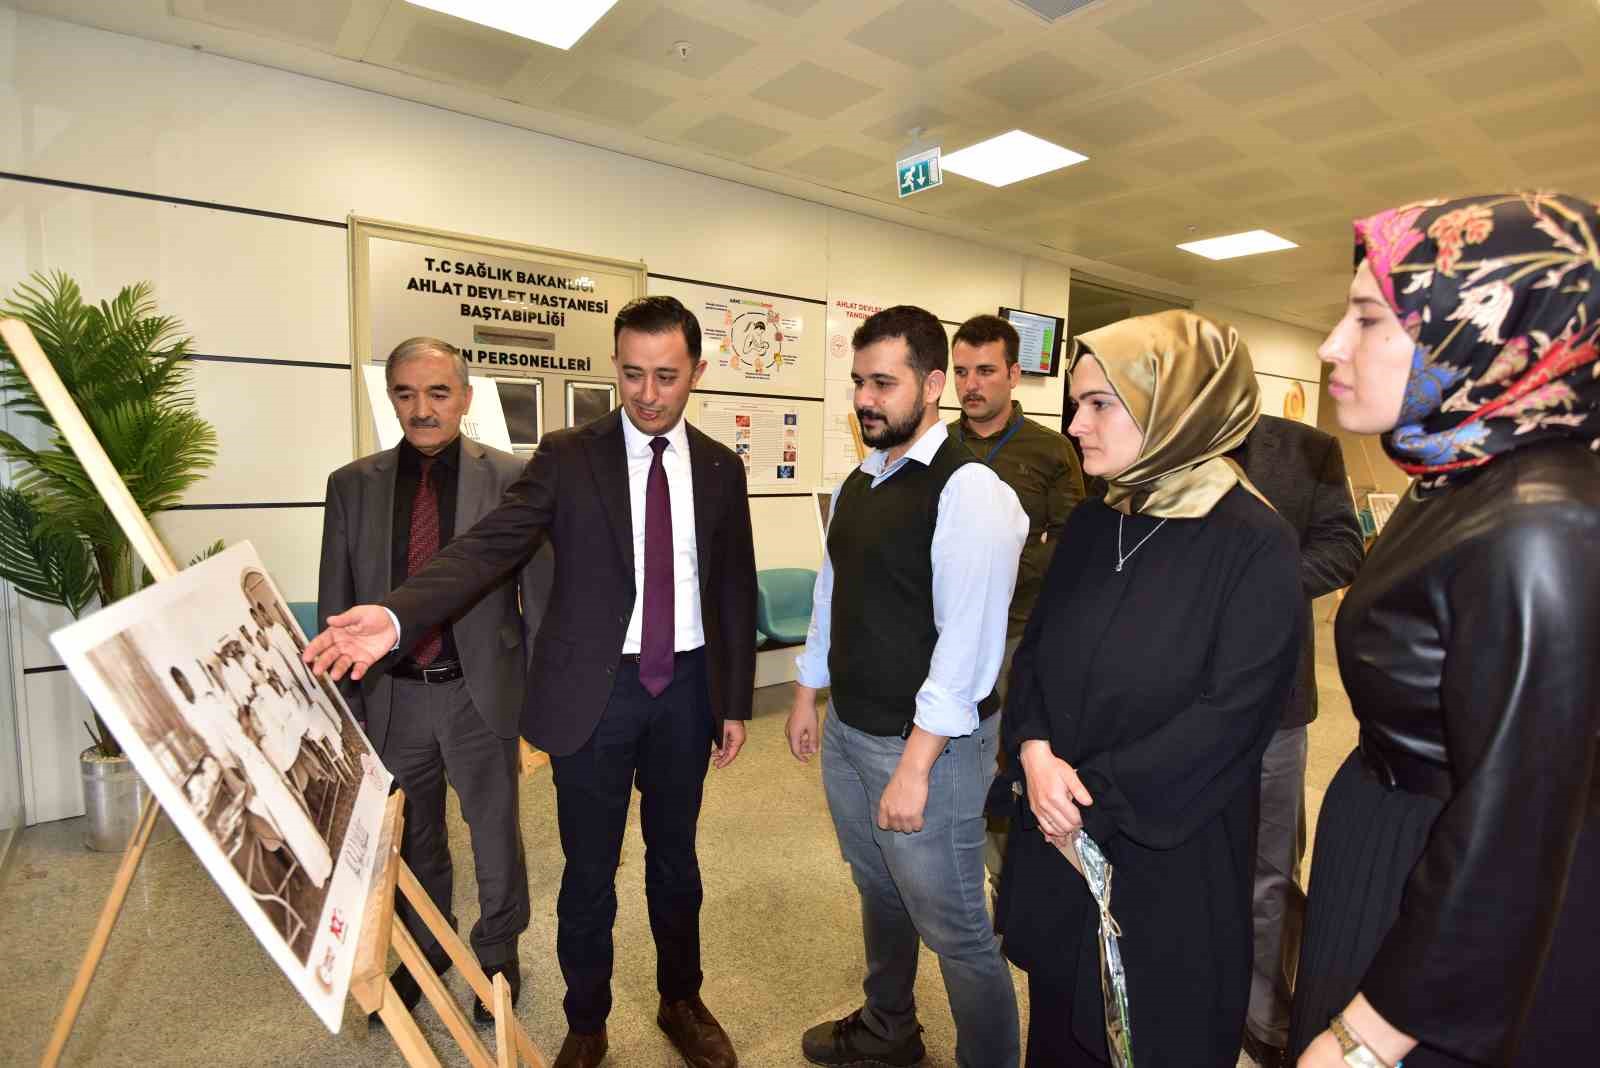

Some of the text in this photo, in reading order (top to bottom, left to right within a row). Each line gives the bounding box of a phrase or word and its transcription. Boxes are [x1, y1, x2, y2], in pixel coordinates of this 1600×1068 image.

[425, 257, 451, 273] T.C
[455, 261, 512, 282] SAĞLIK
[406, 277, 608, 314] AHLAT DEVLET HASTANESİ
[477, 350, 591, 371] PERSONELLERİ
